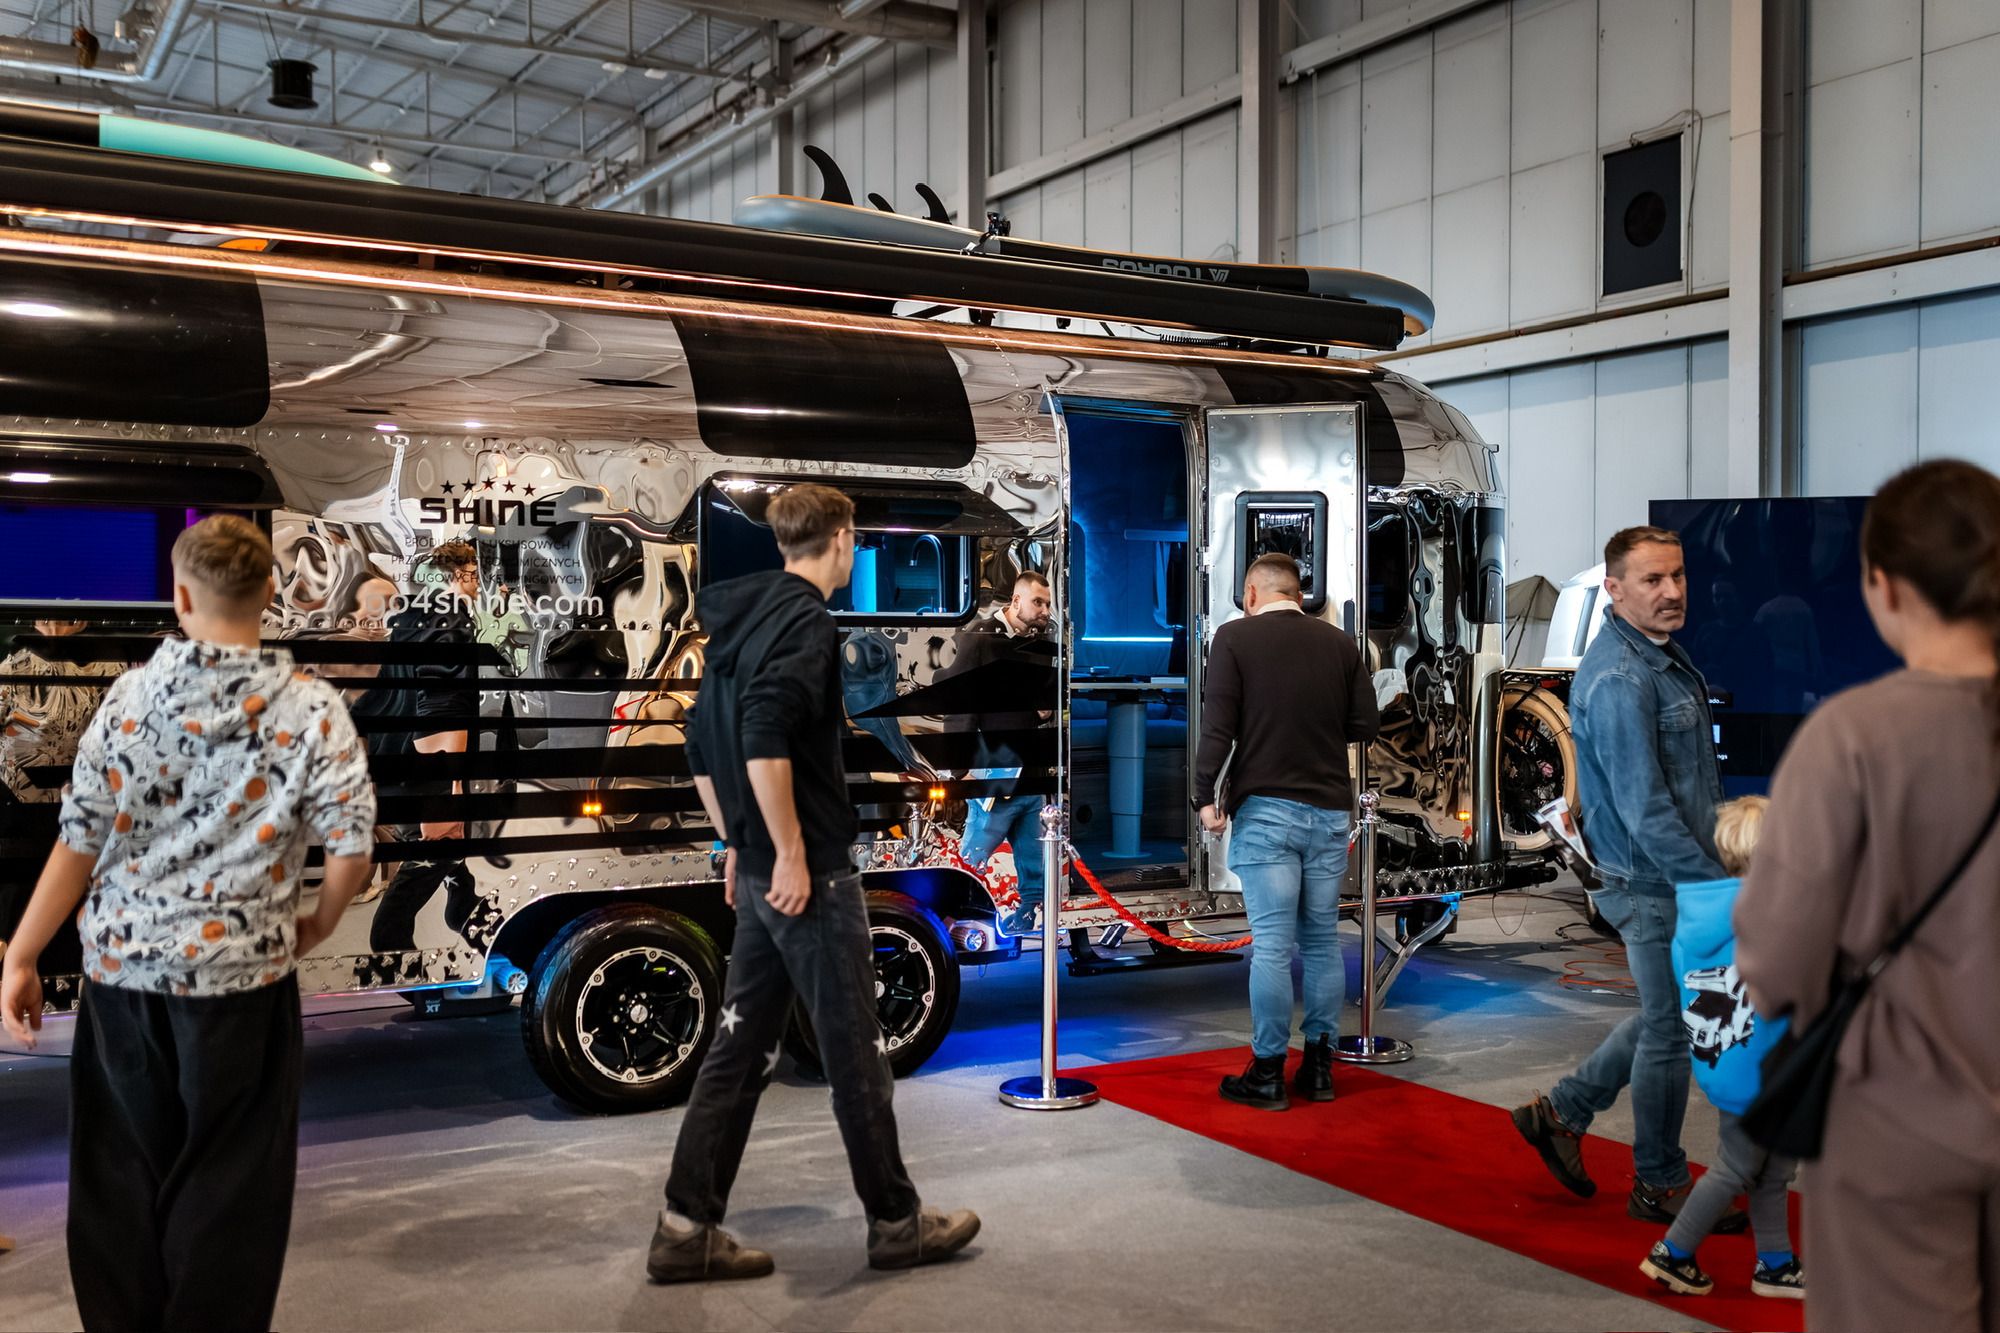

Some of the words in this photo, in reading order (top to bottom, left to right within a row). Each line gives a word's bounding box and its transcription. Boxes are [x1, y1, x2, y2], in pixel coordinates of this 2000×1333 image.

[420, 497, 557, 527] SHINE
[405, 536, 476, 548] PRODUCEN
[366, 586, 604, 620] go4shine.com
[425, 1004, 440, 1013] XT
